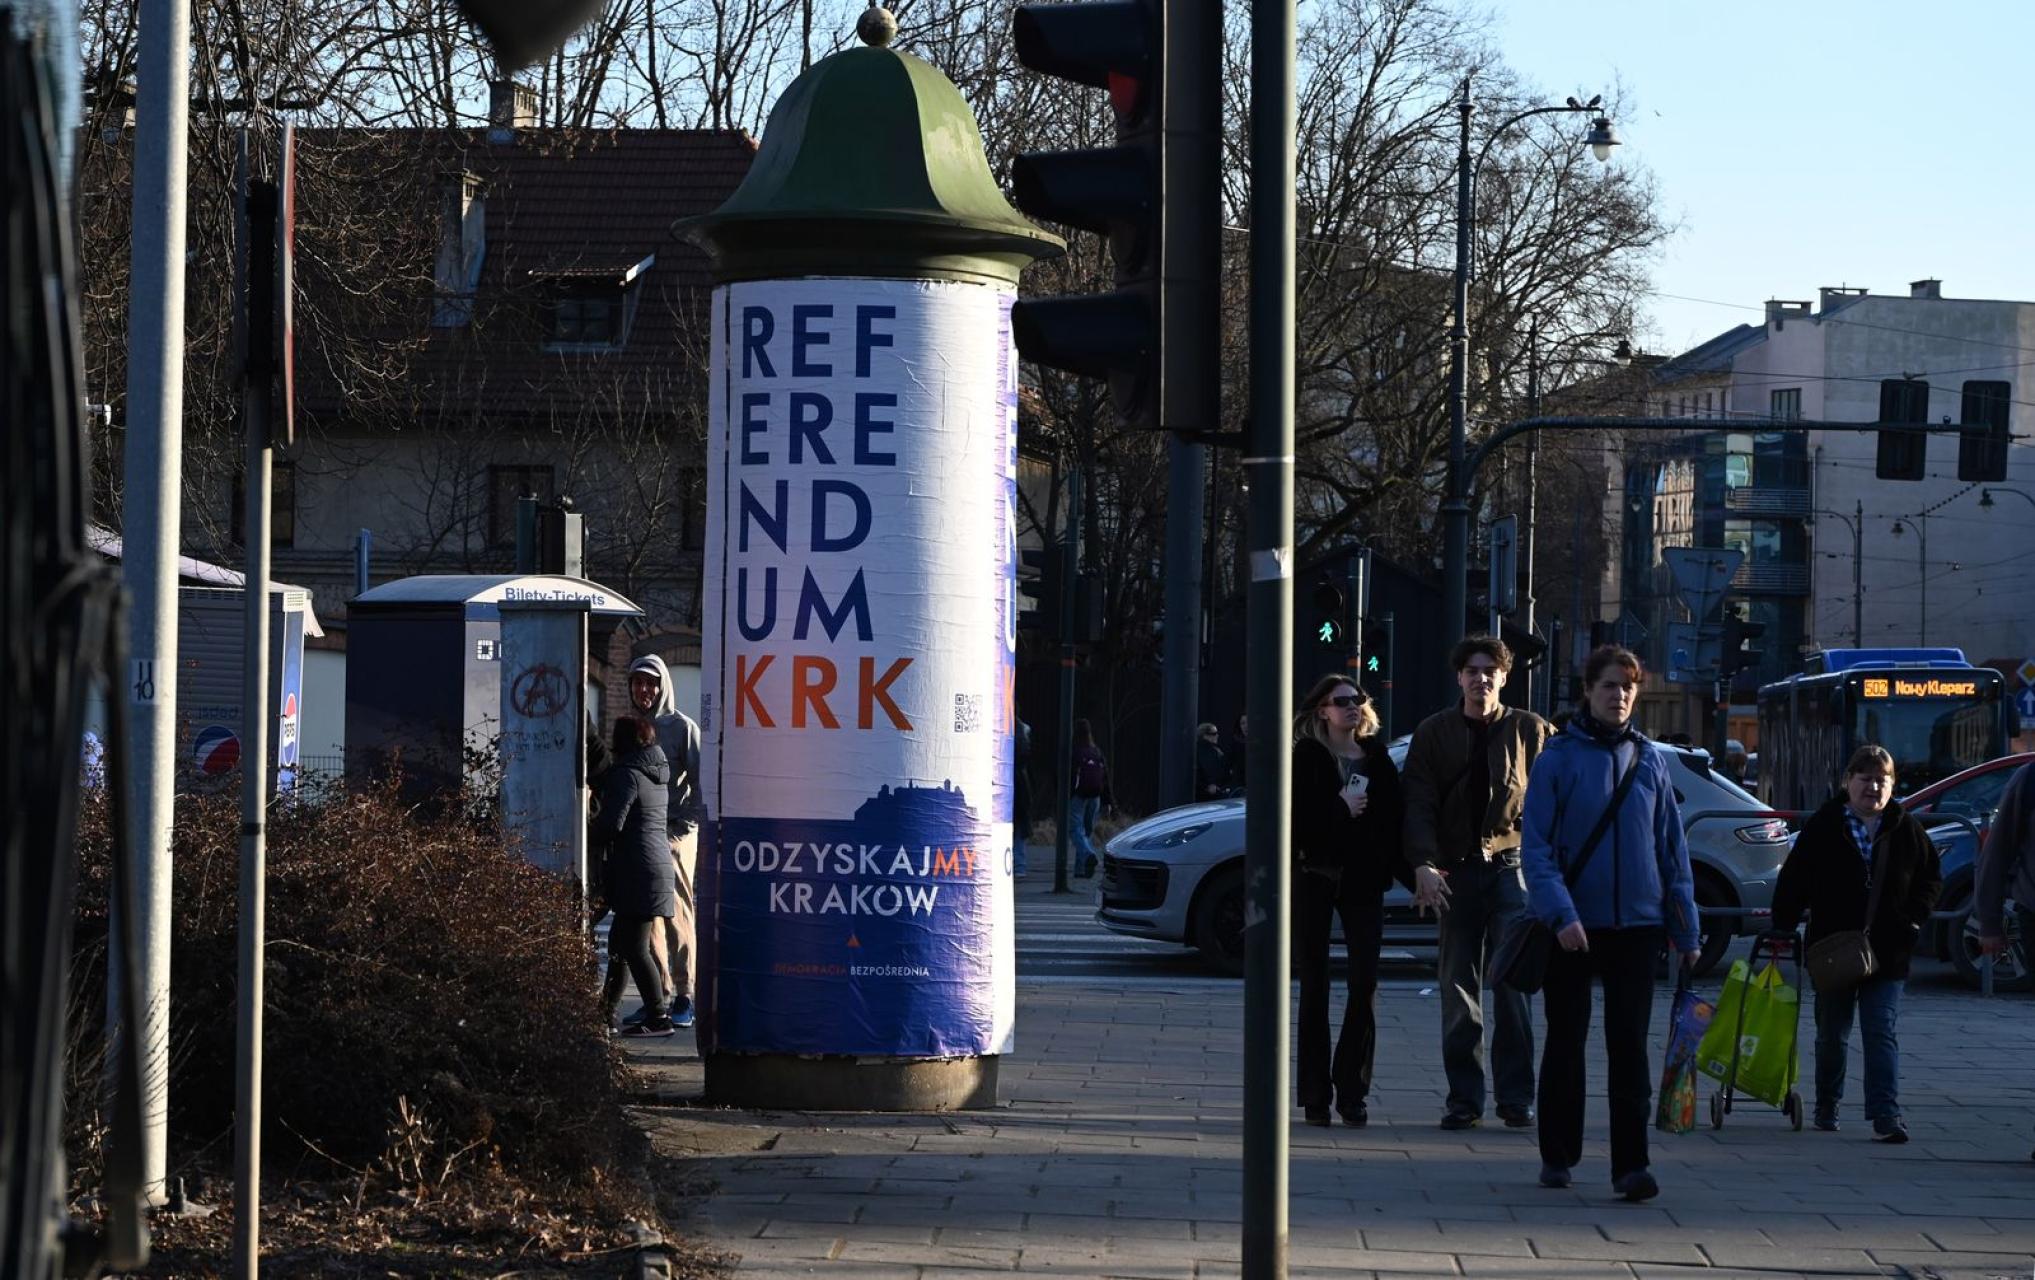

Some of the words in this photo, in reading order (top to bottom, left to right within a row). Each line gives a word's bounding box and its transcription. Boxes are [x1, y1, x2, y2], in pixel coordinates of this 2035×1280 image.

[742, 304, 896, 378] REF
[741, 392, 898, 466] ERE
[739, 478, 872, 555] ND
[737, 564, 874, 644] UM
[735, 654, 914, 731] KRK
[1865, 680, 1888, 696] 502
[1895, 680, 1927, 696] Nowy
[1927, 680, 1975, 696] Kleparz
[850, 964, 930, 977] BEZPOŚREDNIA
